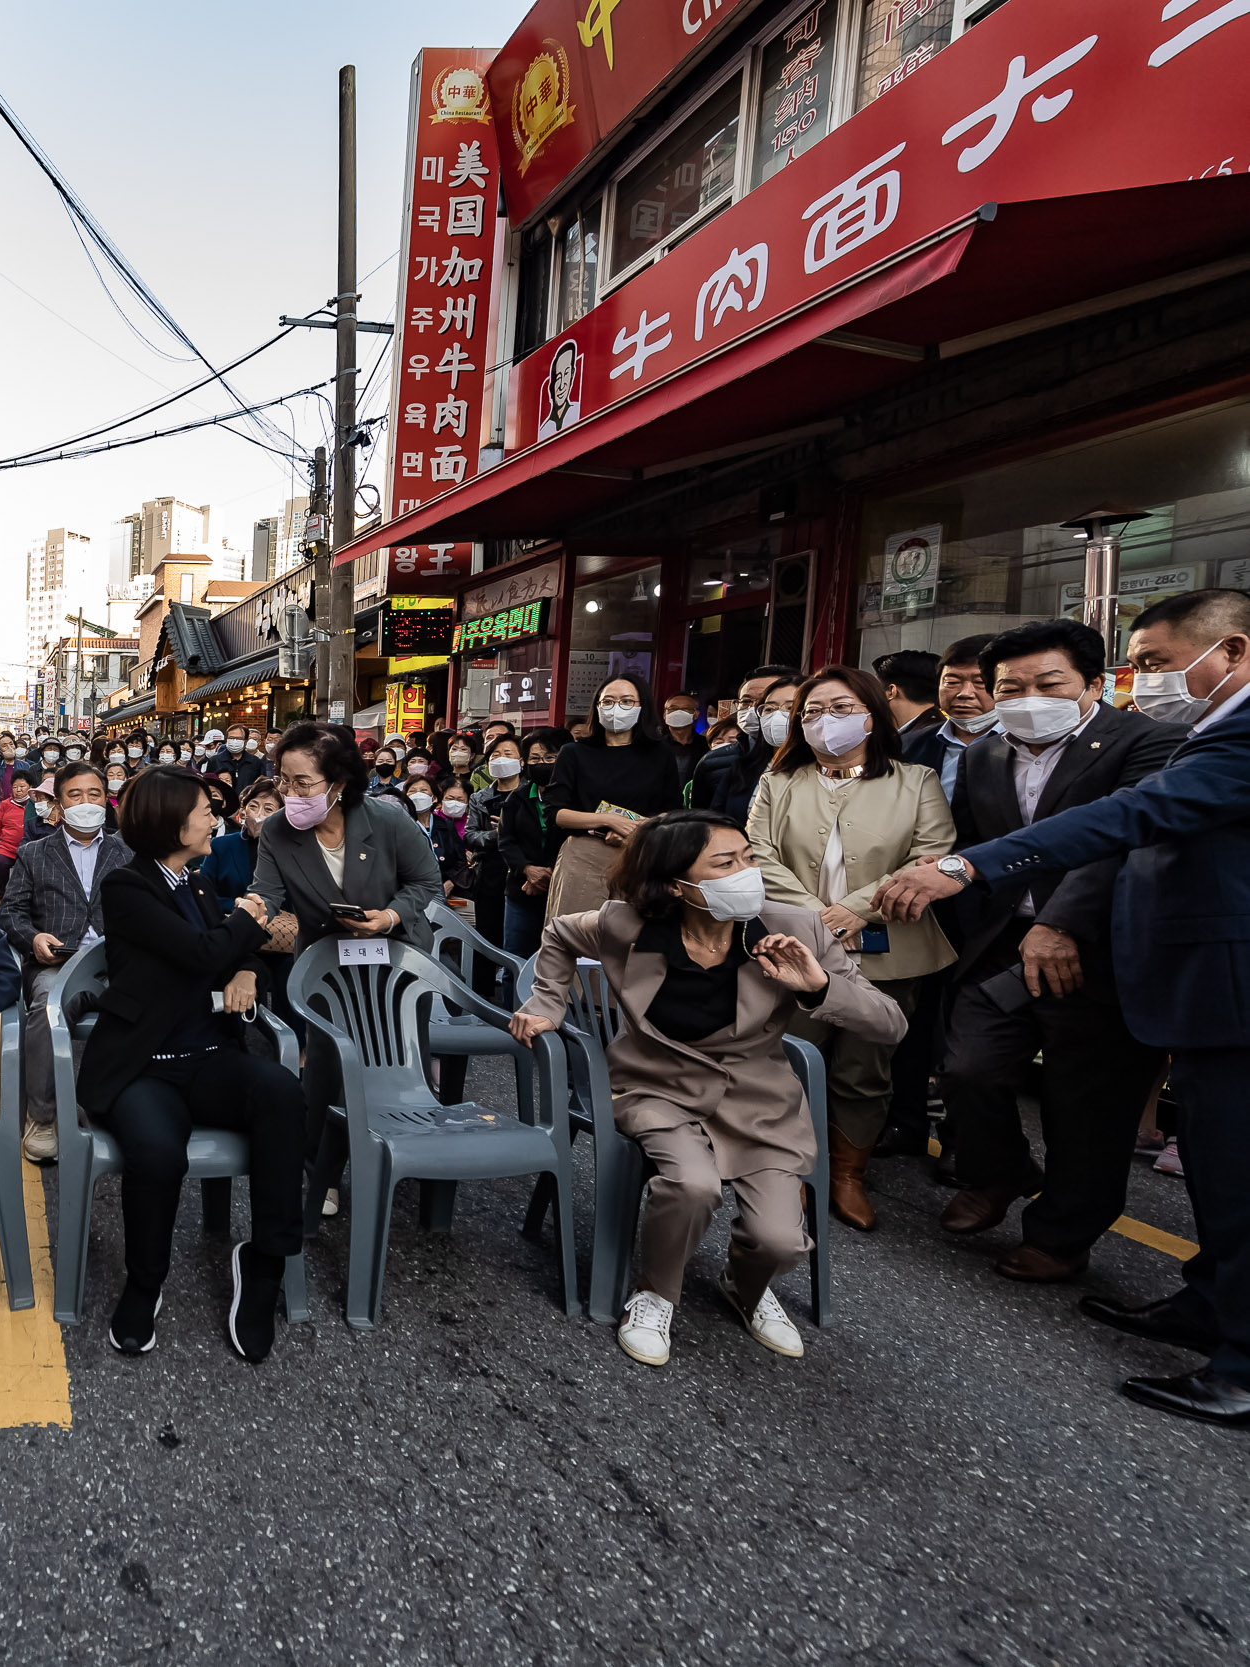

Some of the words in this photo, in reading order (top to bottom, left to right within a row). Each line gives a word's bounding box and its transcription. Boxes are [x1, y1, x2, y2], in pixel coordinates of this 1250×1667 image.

[454, 109, 482, 117] Restaurant
[419, 138, 491, 578] 美国加州牛肉面王
[585, 653, 595, 661] 10
